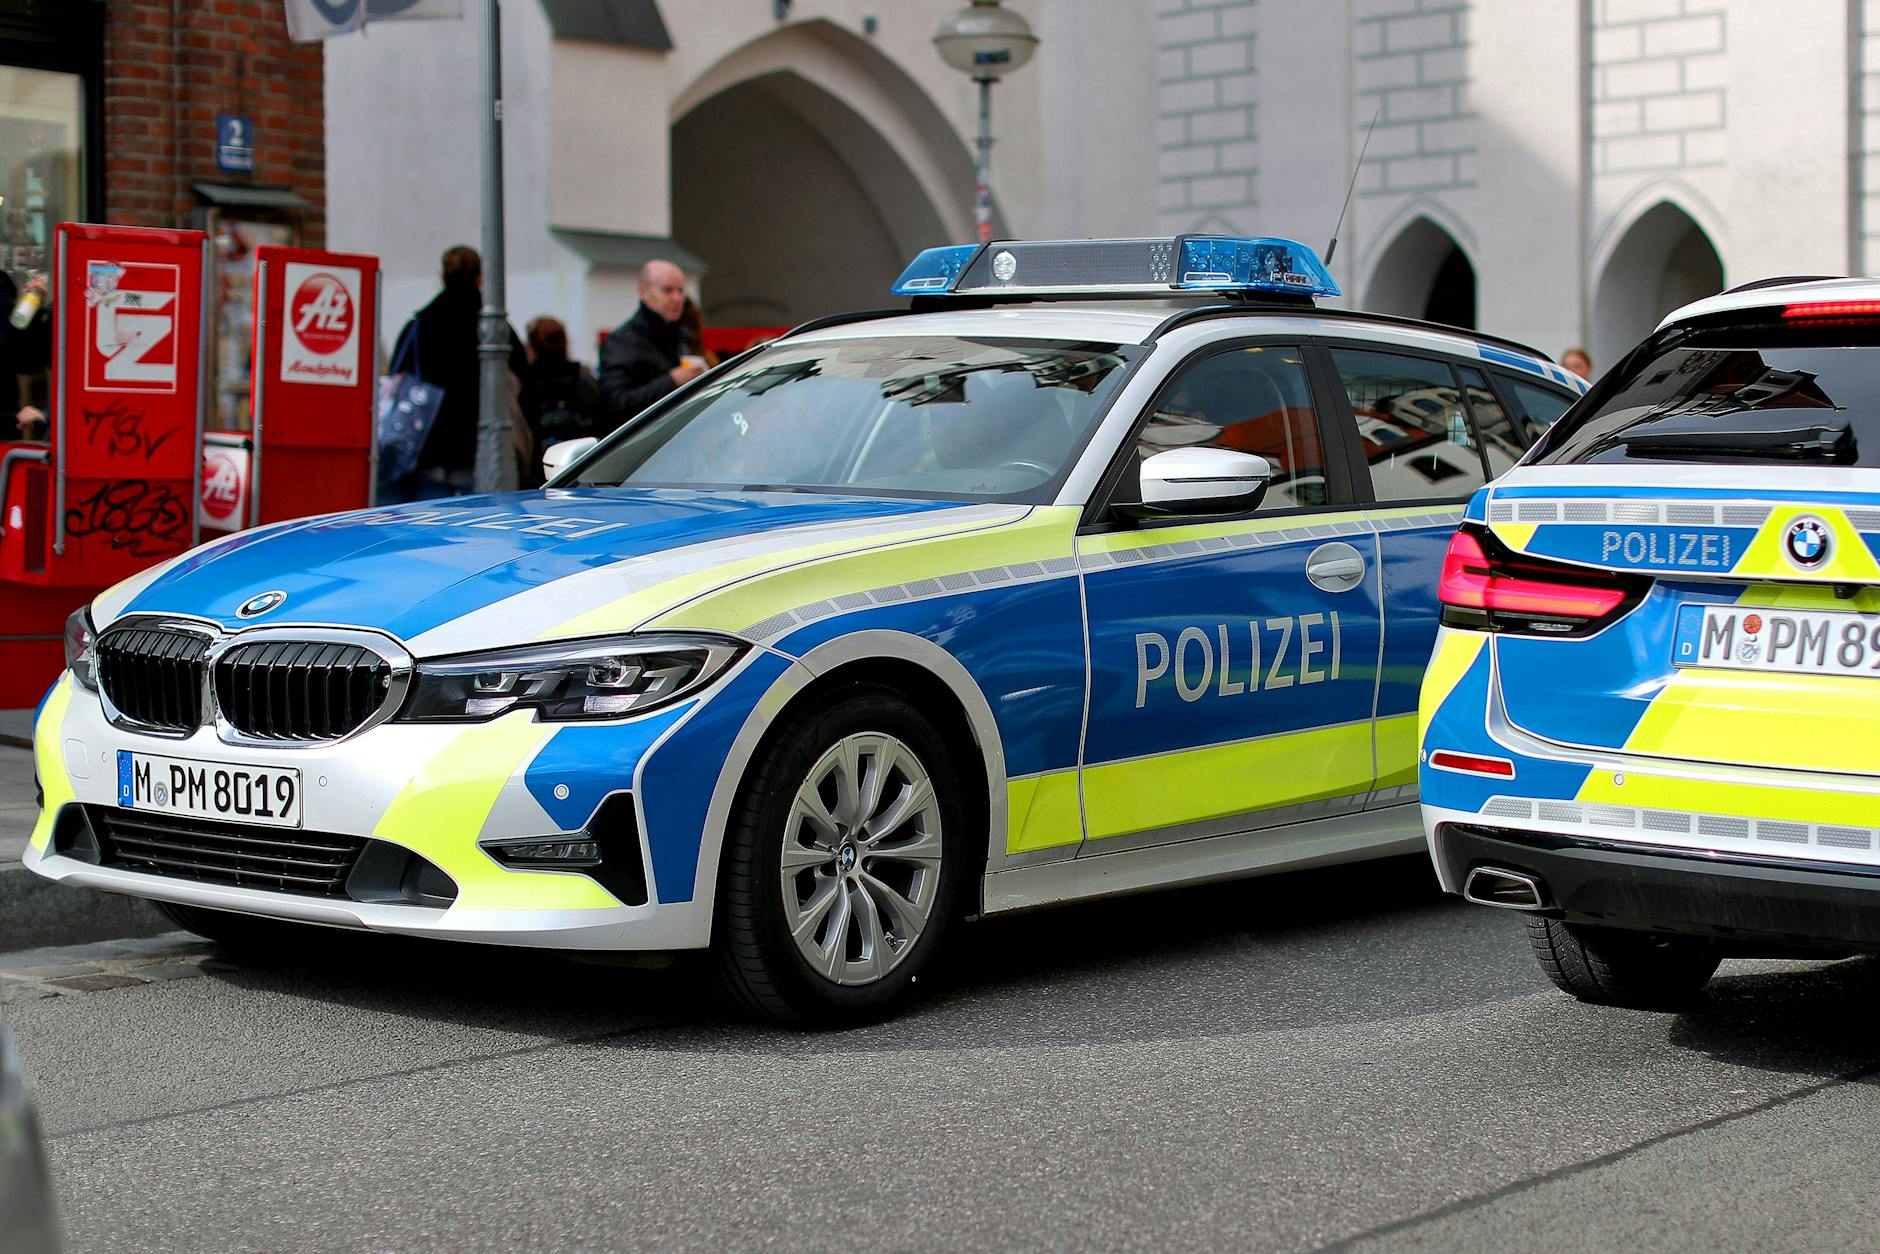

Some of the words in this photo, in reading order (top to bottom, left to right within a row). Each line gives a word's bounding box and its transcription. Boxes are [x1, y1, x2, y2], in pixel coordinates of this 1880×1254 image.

[311, 511, 630, 539] POLIZEI
[1601, 531, 1731, 567] POLIZEI
[1135, 610, 1341, 709] POLIZEI
[213, 770, 295, 818] 8019
